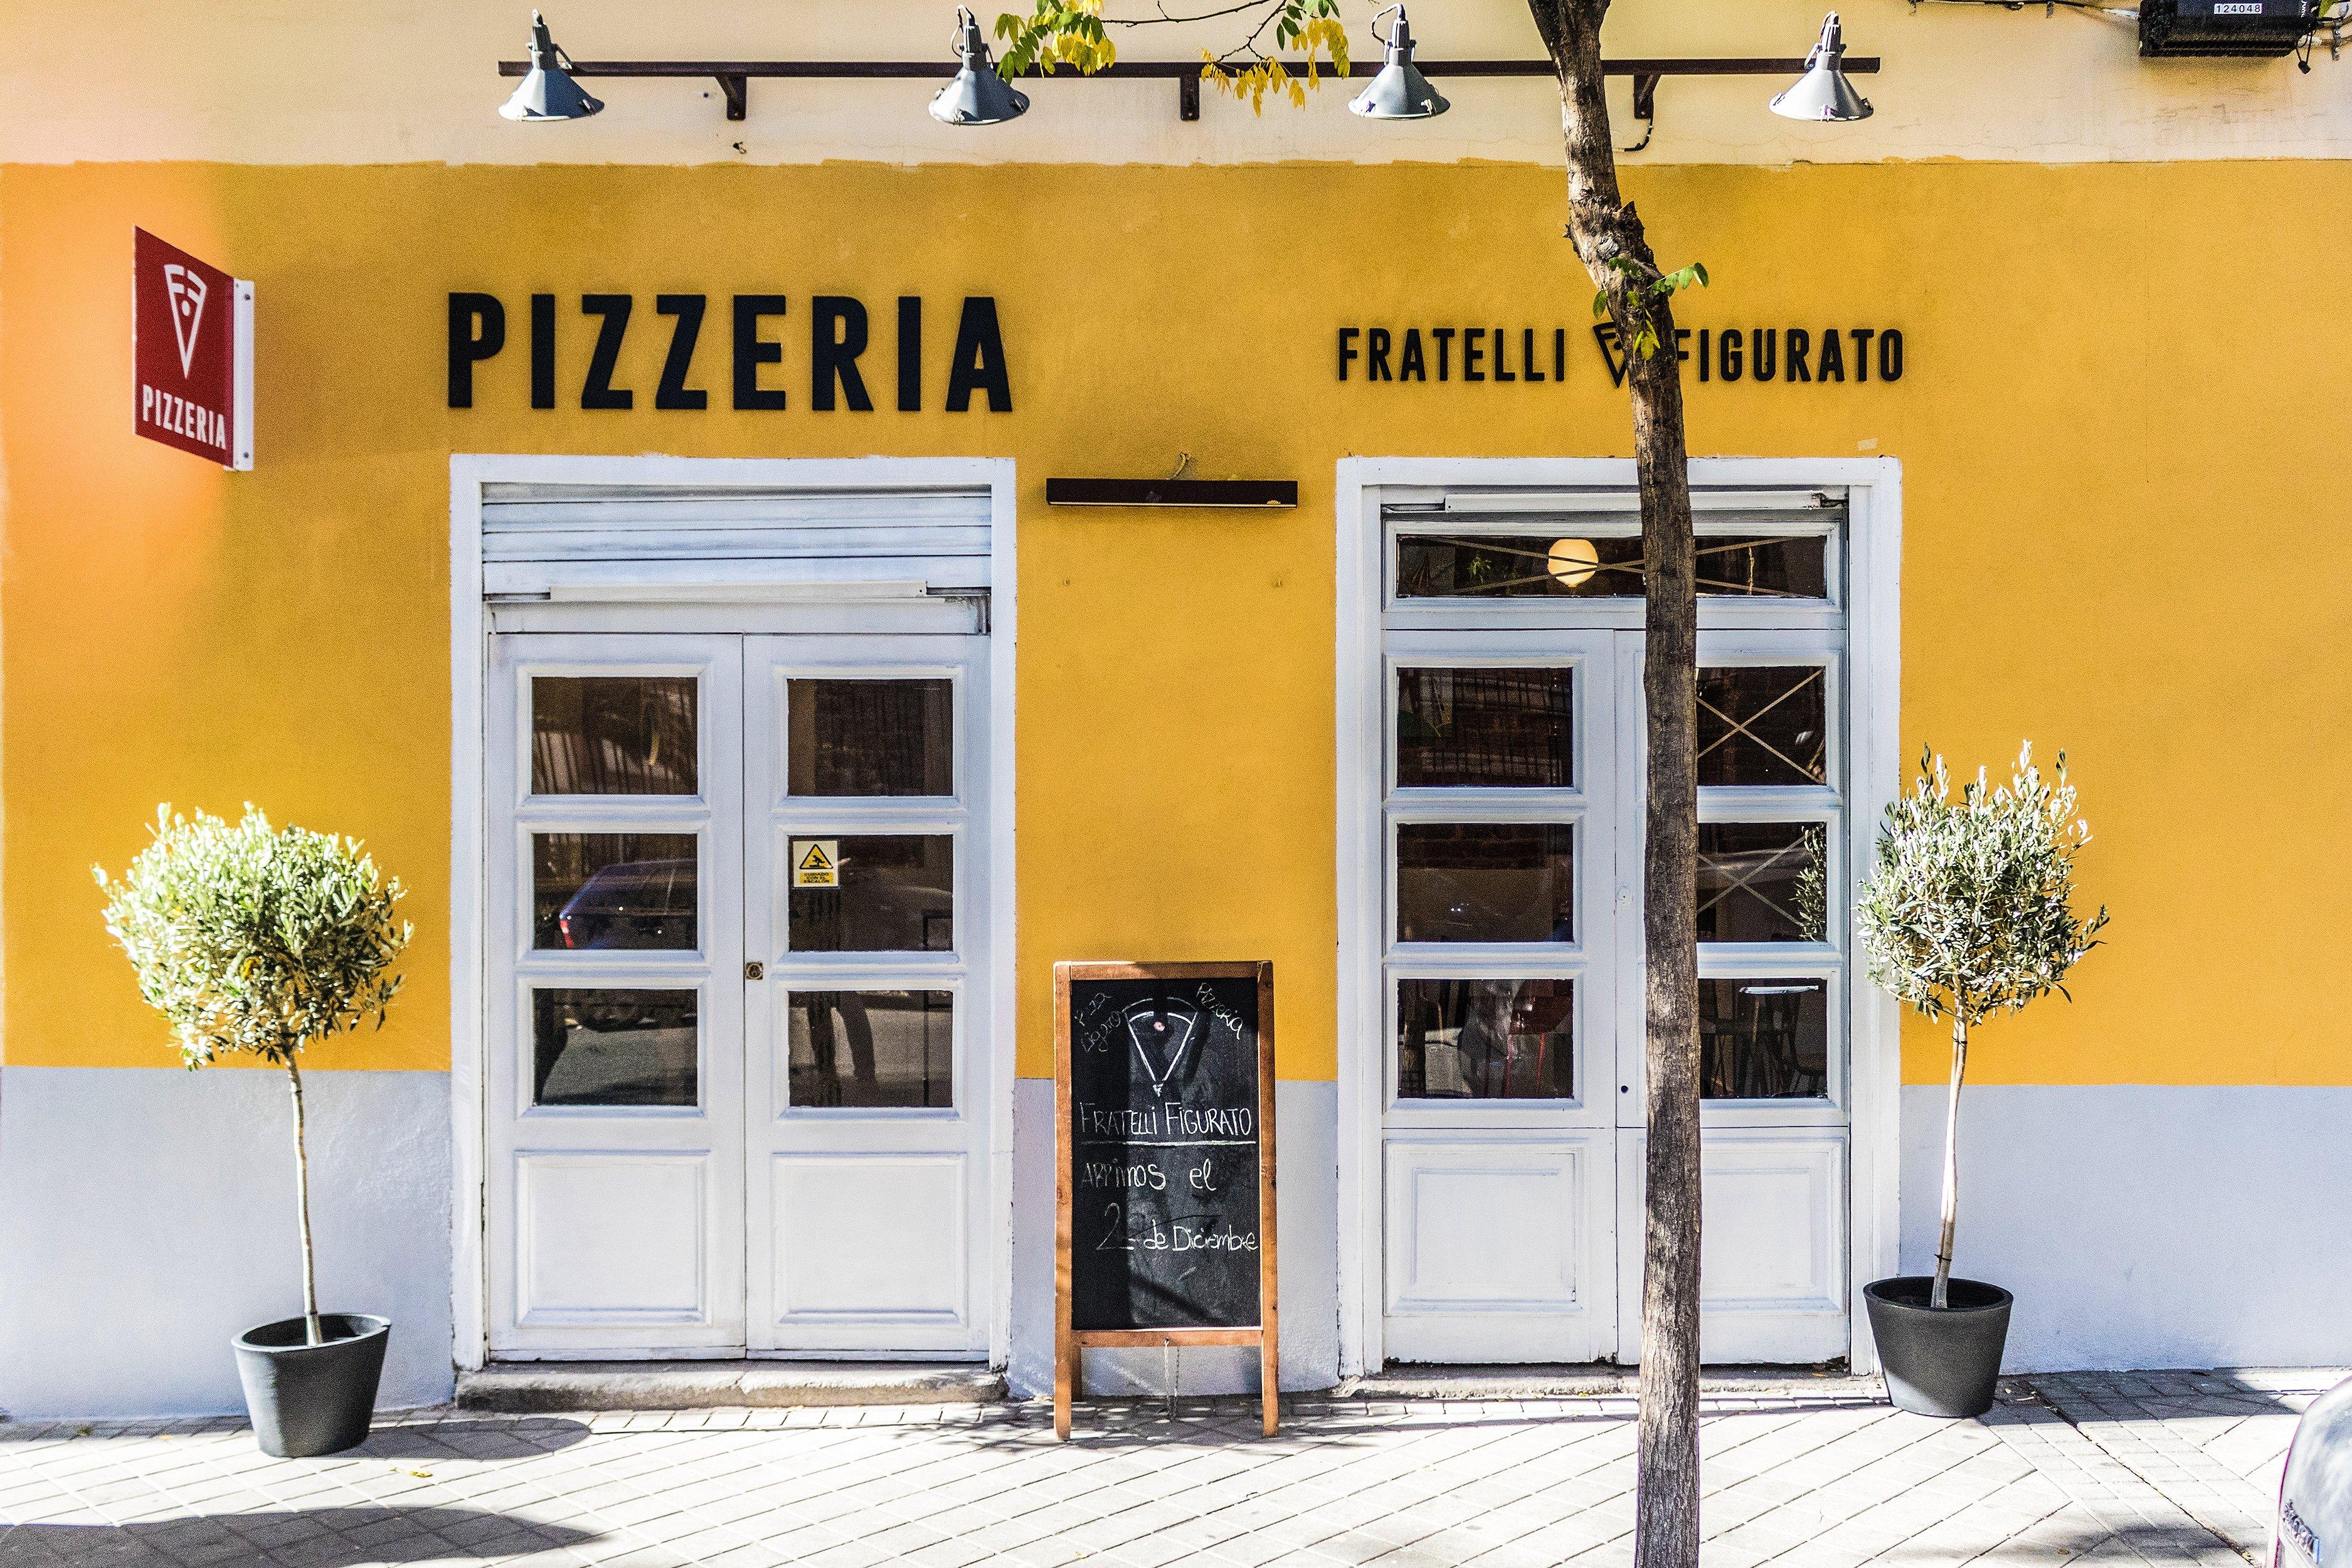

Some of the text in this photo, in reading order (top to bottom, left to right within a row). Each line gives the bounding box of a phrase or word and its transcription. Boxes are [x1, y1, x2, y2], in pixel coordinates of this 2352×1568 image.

[2216, 4, 2260, 13] 124048
[447, 292, 1014, 413] PIZZERIA
[1338, 327, 1565, 382] FRATELLI
[143, 384, 226, 444] PIZZERIA
[1189, 1158, 1217, 1191] el
[1143, 1219, 1168, 1250] de
[1172, 1224, 1259, 1252] Diciembre
